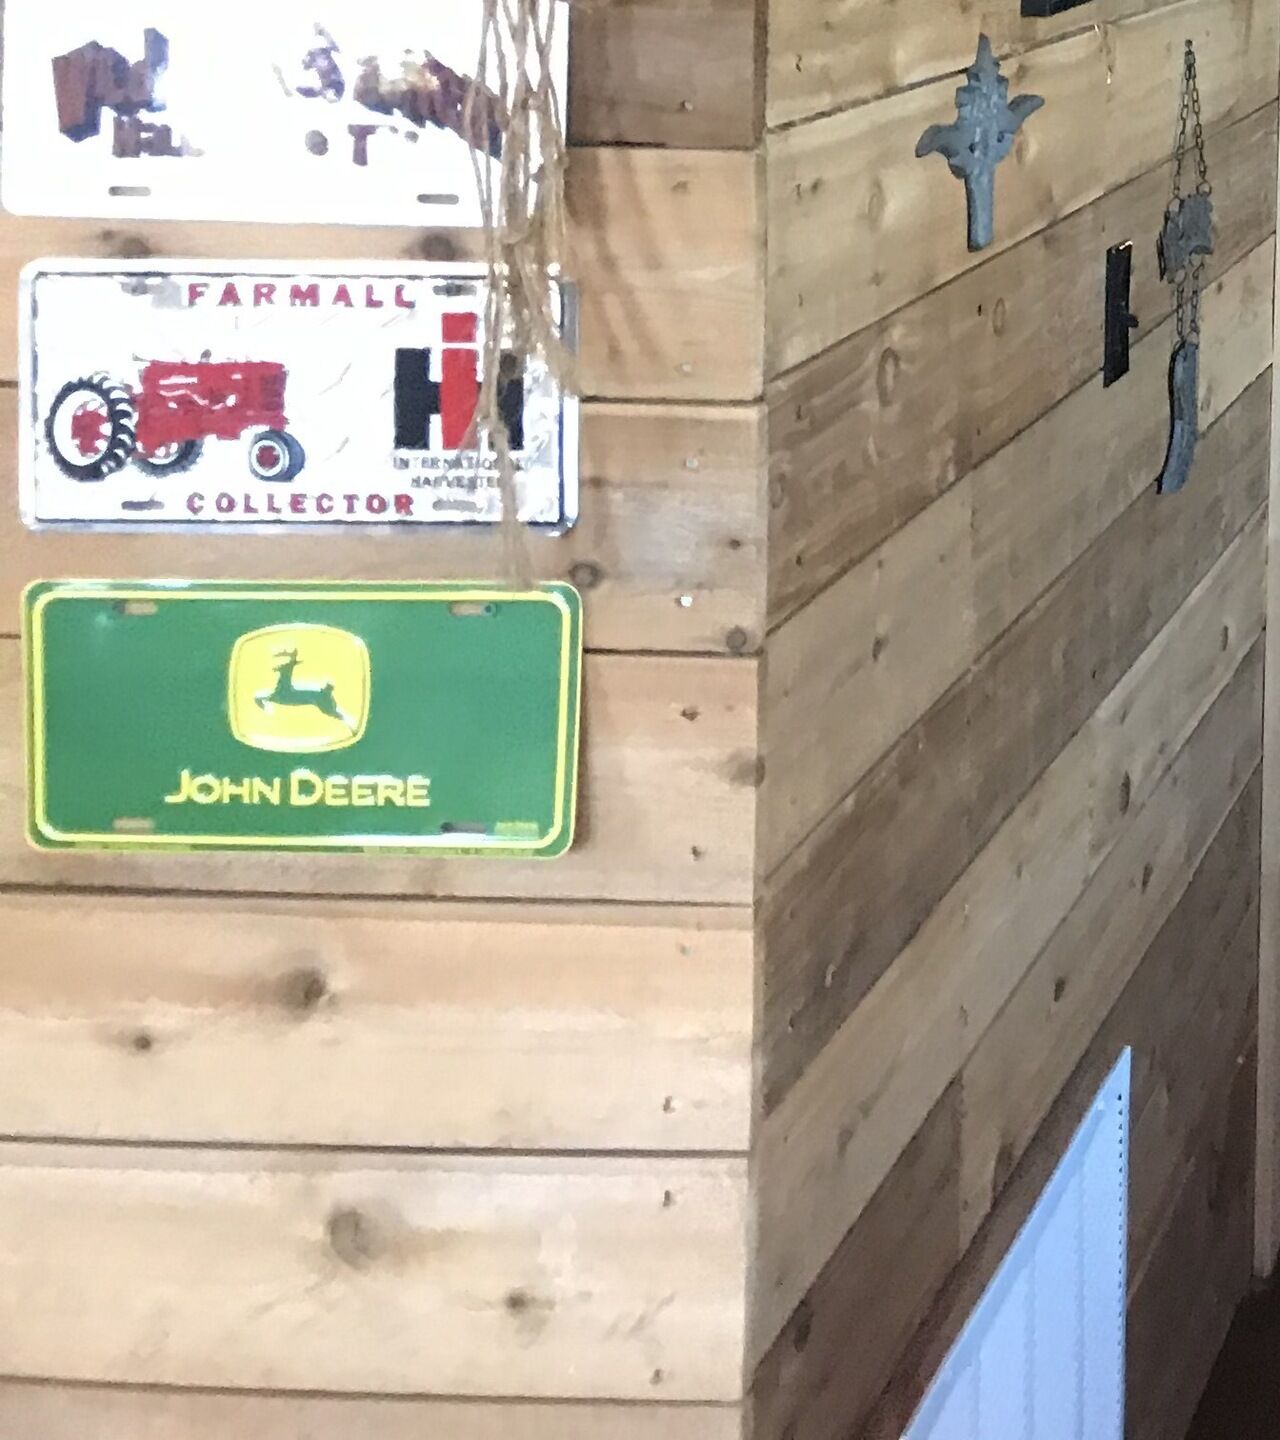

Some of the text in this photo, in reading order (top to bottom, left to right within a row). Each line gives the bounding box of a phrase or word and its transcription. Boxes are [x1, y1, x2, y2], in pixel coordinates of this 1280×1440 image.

[187, 282, 417, 310] FARMALL
[185, 491, 416, 517] COLLECTOR
[164, 768, 432, 808] JOHN DEERE
